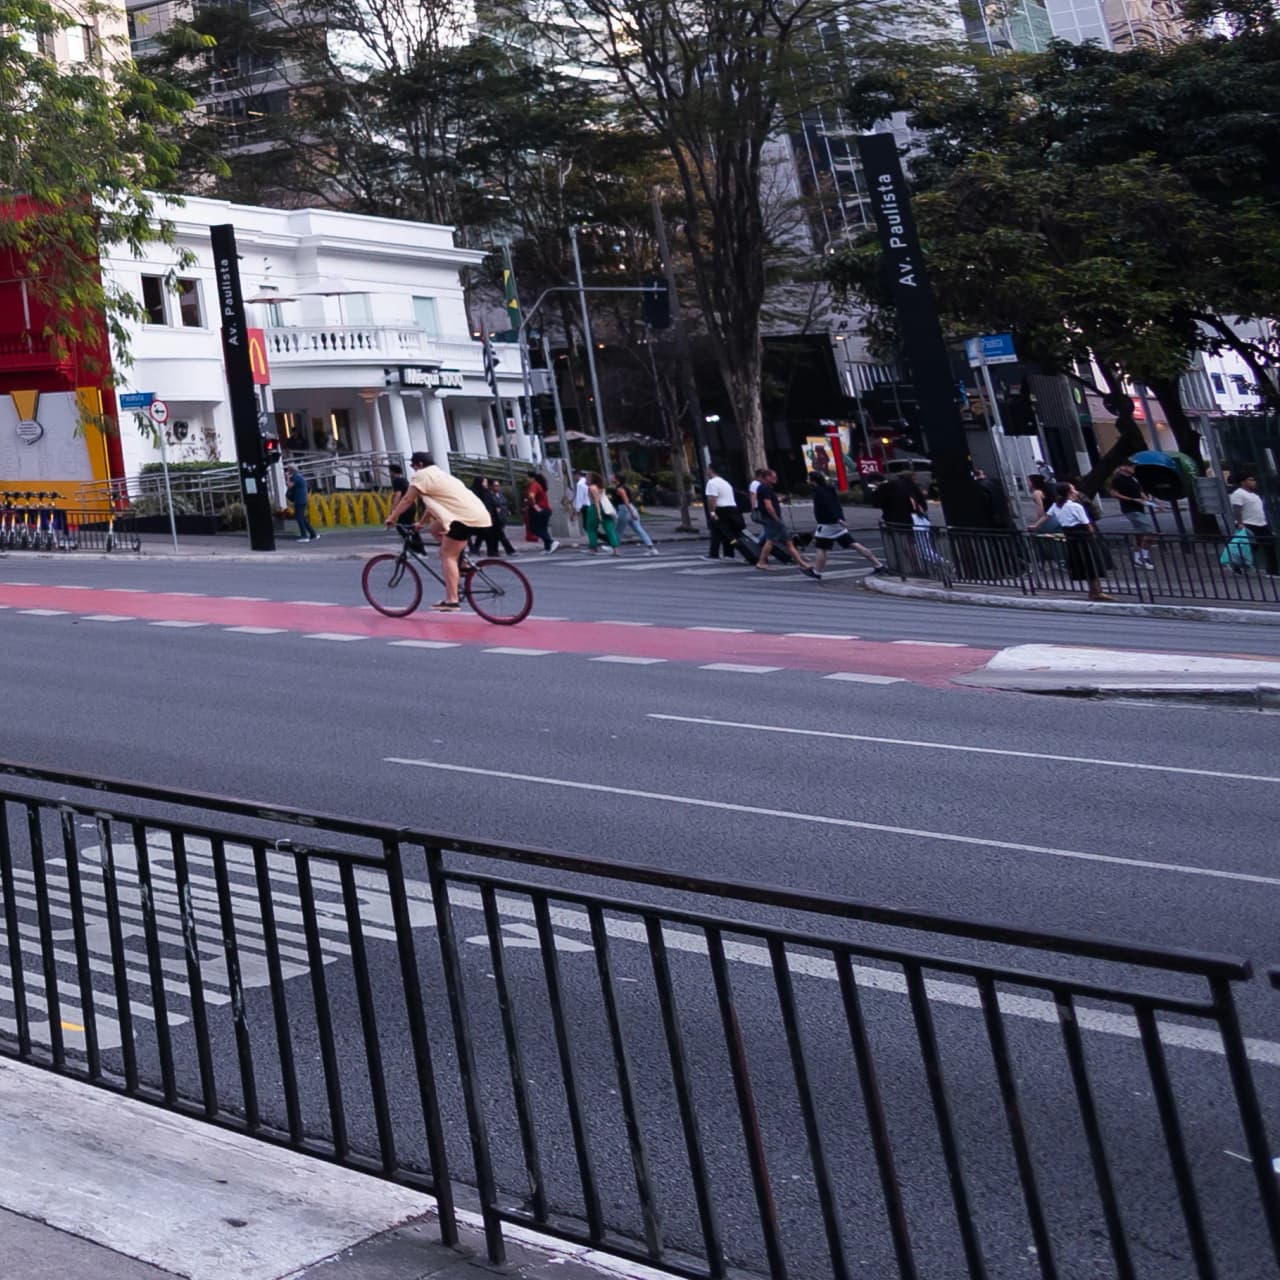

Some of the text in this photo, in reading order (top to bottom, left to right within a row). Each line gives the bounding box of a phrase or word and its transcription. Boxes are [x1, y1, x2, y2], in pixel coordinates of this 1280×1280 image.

[877, 174, 918, 287] Av. Paulista
[220, 259, 239, 346] Av. Paulista
